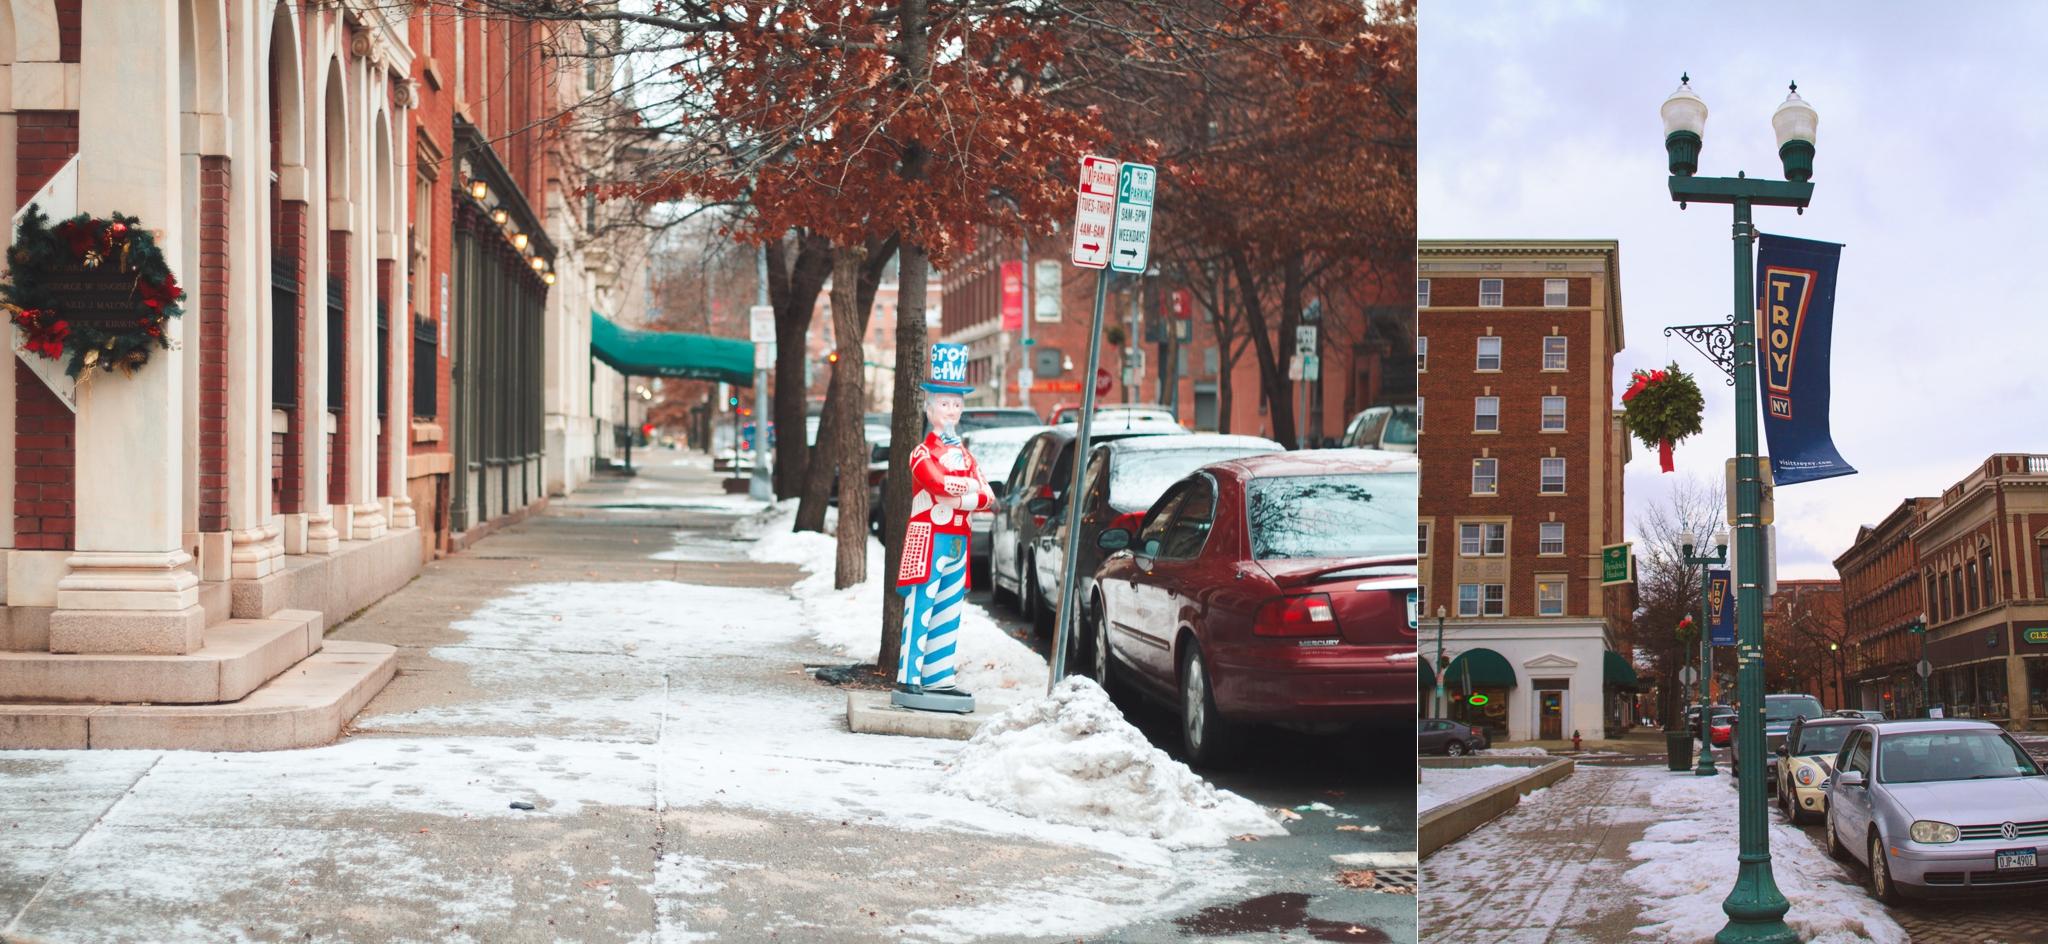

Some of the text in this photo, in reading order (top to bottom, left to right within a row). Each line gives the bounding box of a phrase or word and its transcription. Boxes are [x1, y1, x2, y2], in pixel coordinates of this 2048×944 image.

[1082, 165, 1115, 186] NO PARKING
[1121, 171, 1148, 197] 2 HR
[1131, 187, 1151, 202] PARKING
[1081, 197, 1111, 215] TUES-THUR
[1121, 207, 1147, 223] 9AM-5PM
[1079, 223, 1106, 238] 4AM-6AM
[1118, 228, 1146, 243] WEEKDAYS
[49, 282, 82, 291] GEORGE
[85, 282, 94, 291] W
[97, 301, 134, 309] MALONE
[93, 320, 102, 328] W
[105, 320, 139, 328] KIRWIN
[1771, 280, 1791, 373] TROY
[1772, 399, 1788, 414] NY
[1299, 639, 1340, 647] MERCURY
